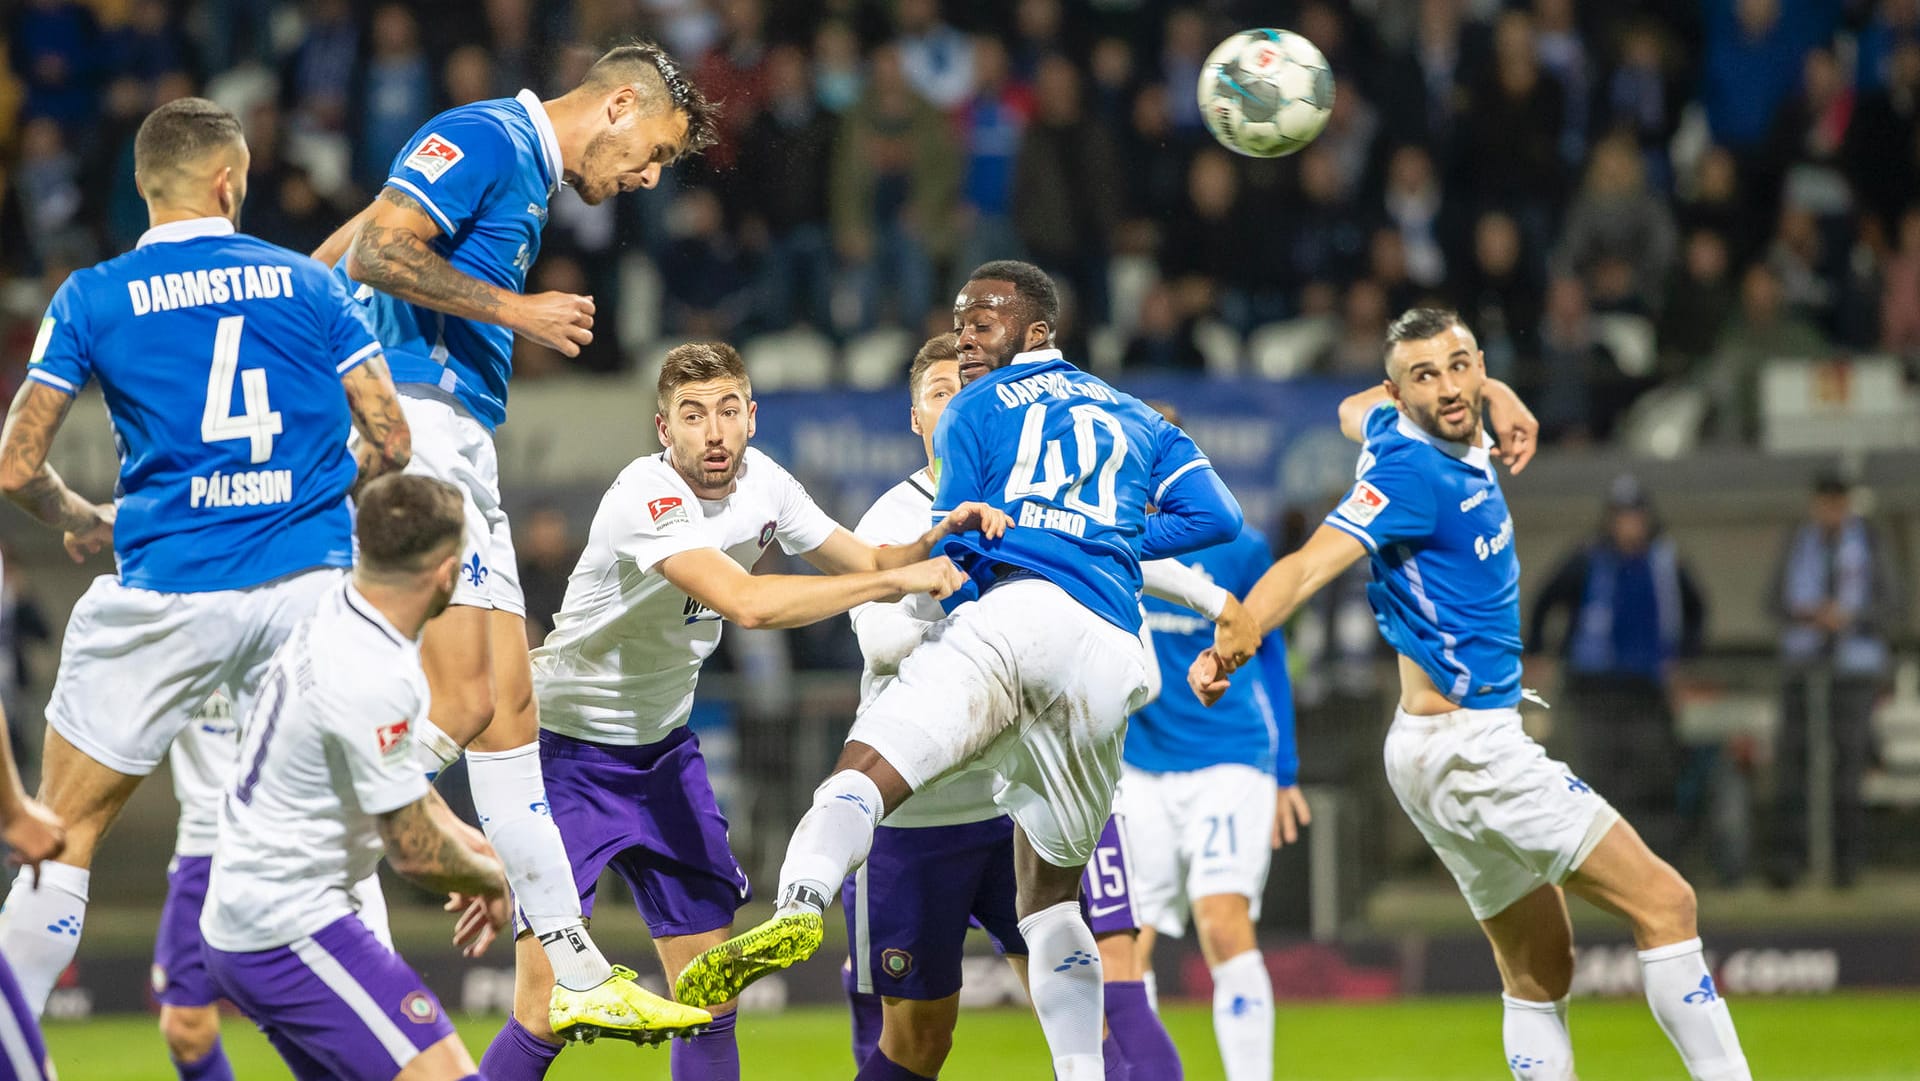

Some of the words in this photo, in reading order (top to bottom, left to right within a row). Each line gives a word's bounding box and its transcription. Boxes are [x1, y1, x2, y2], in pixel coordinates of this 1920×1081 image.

[127, 265, 294, 316] DARMSTADT
[201, 315, 283, 464] 4
[189, 470, 292, 508] PÁLSSON
[1004, 402, 1128, 526] 40
[1203, 814, 1238, 858] 21
[1087, 847, 1127, 899] 15
